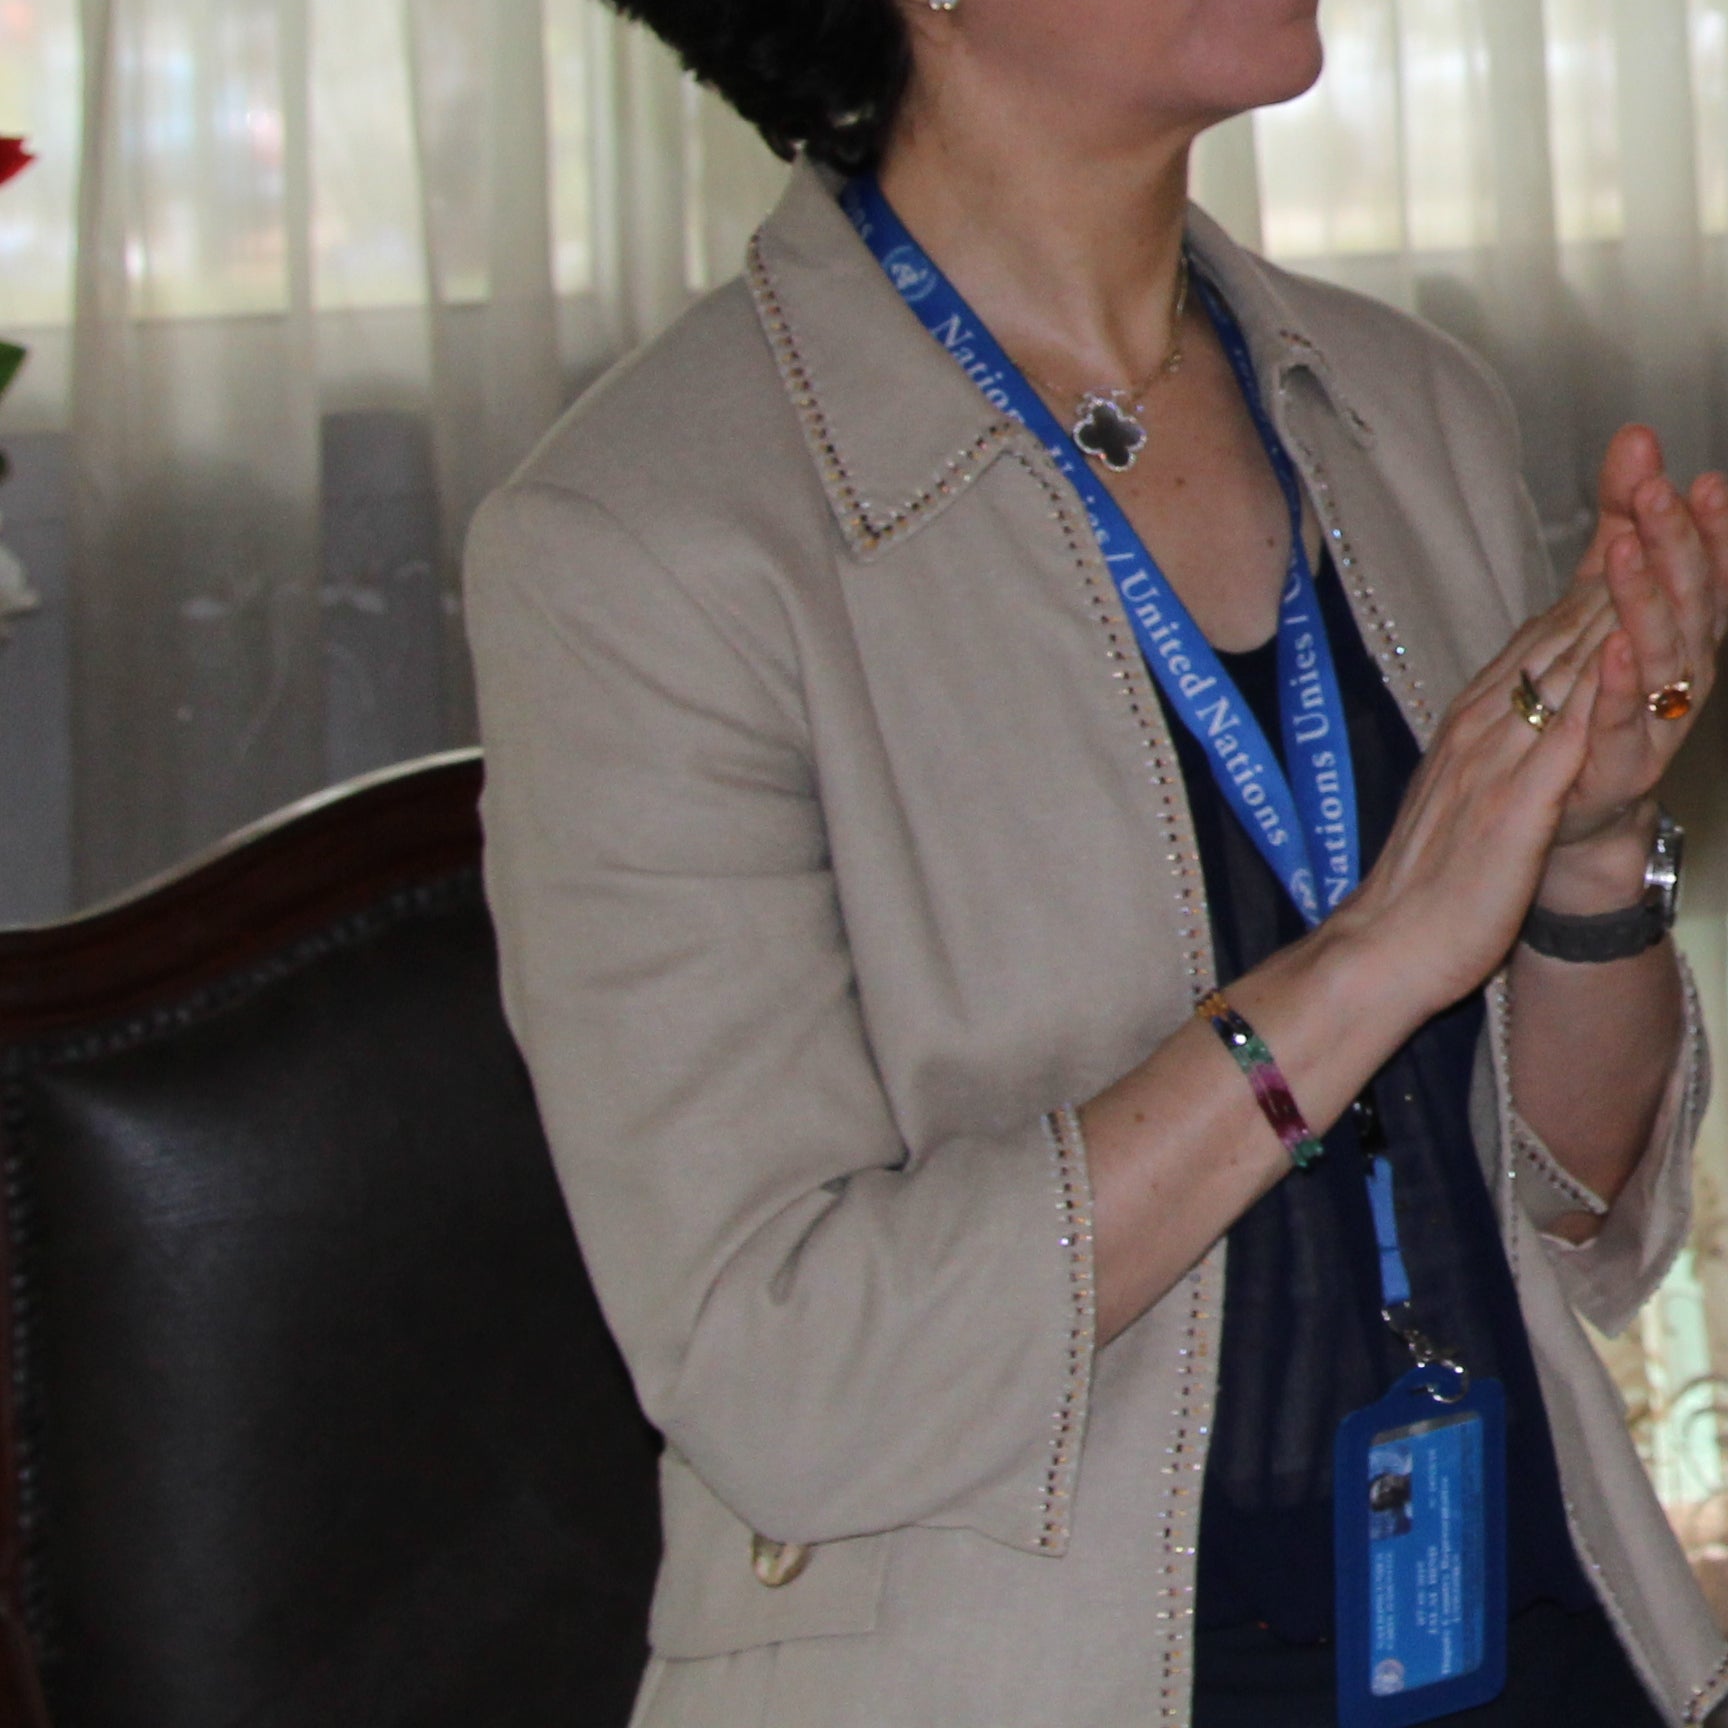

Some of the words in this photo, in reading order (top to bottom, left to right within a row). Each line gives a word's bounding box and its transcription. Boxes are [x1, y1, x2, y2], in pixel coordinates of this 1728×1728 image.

[1120, 567, 1217, 699] United
[1195, 695, 1288, 847] Nations
[1289, 633, 1330, 744] Unies
[1311, 751, 1349, 907] Nations
